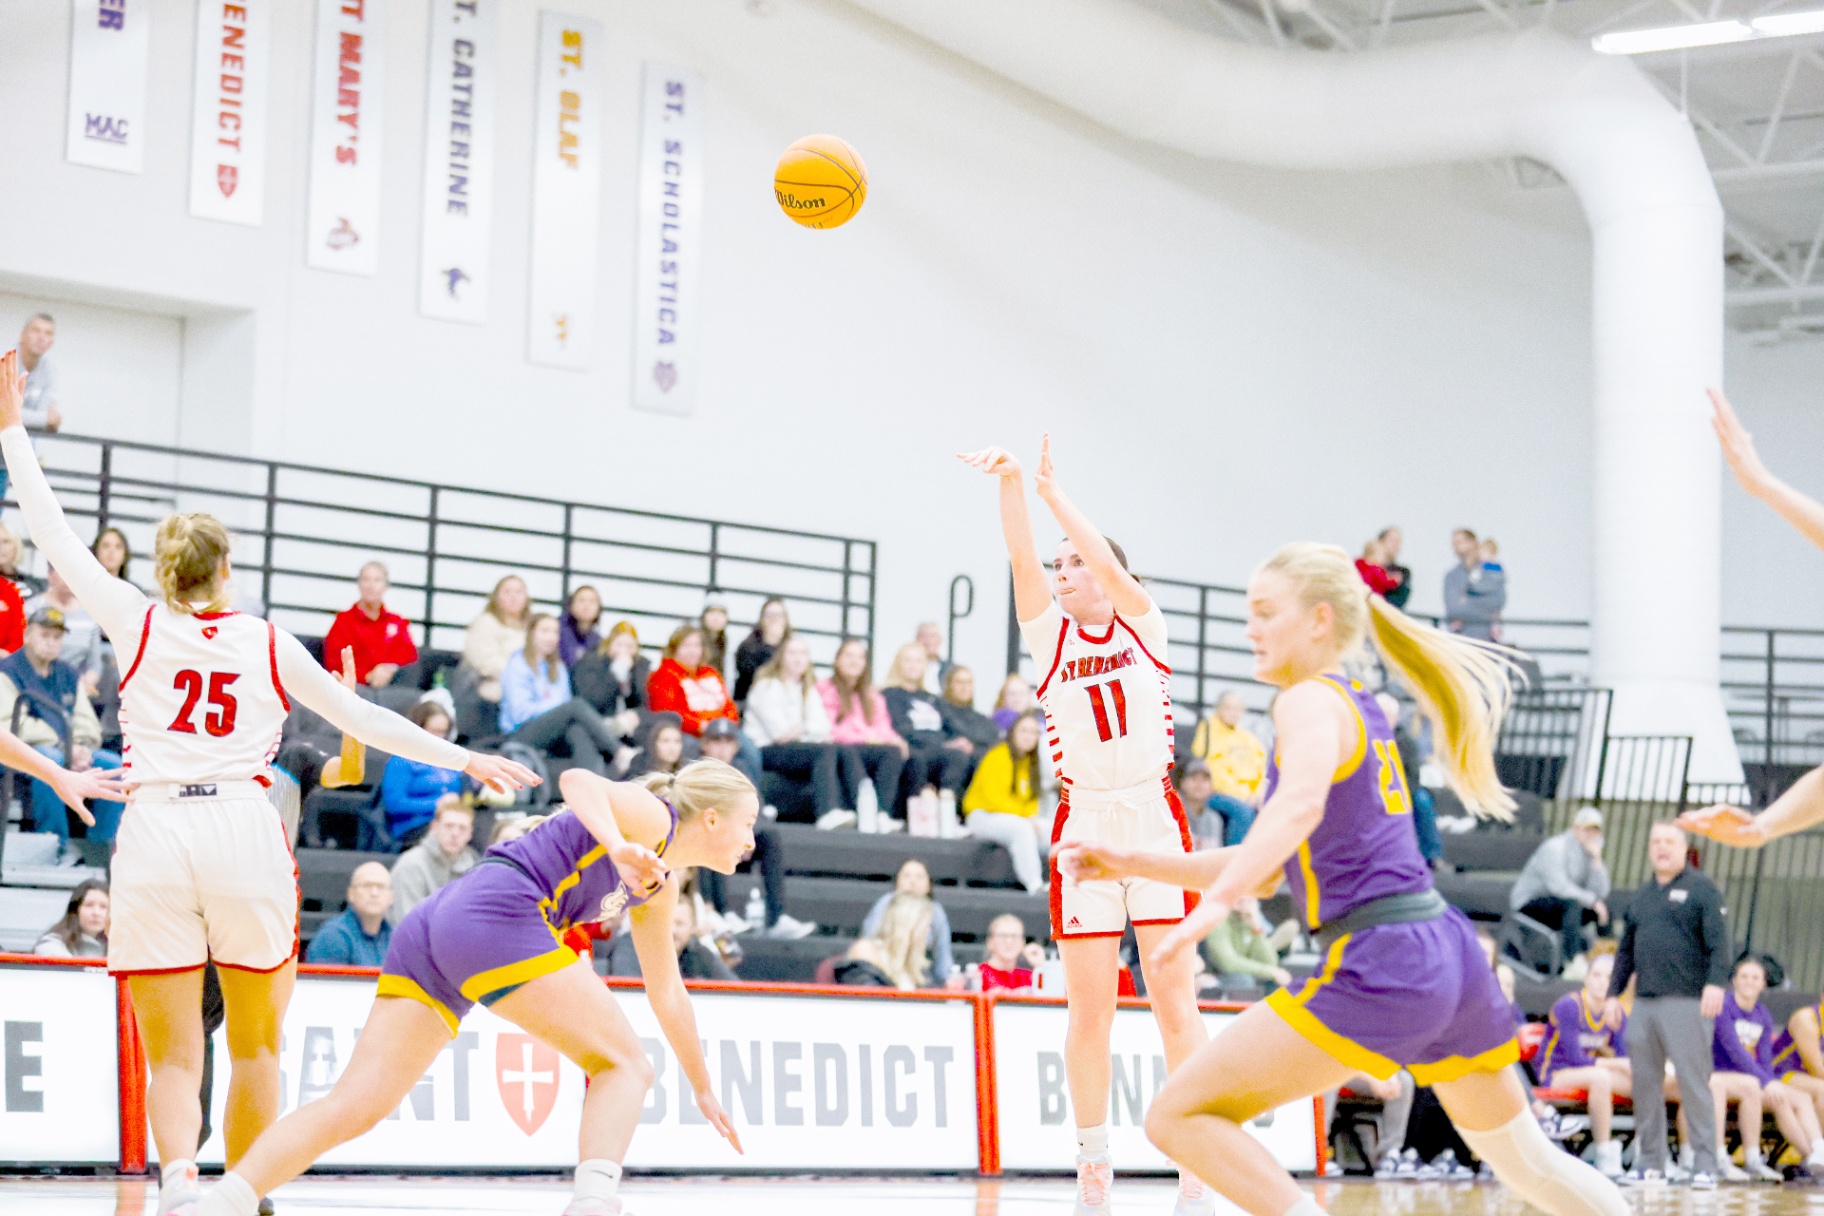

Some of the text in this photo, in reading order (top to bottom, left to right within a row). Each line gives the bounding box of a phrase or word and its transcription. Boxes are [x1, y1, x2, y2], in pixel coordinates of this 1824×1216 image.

[217, 0, 247, 151] ENEDICT
[335, 32, 363, 165] MARY'S
[560, 29, 582, 76] ST.
[447, 38, 475, 215] CATHERINE
[657, 80, 684, 345] ST. SCHOLASTICA
[167, 669, 241, 737] 25
[1084, 678, 1128, 743] 11
[4, 1020, 44, 1113] E
